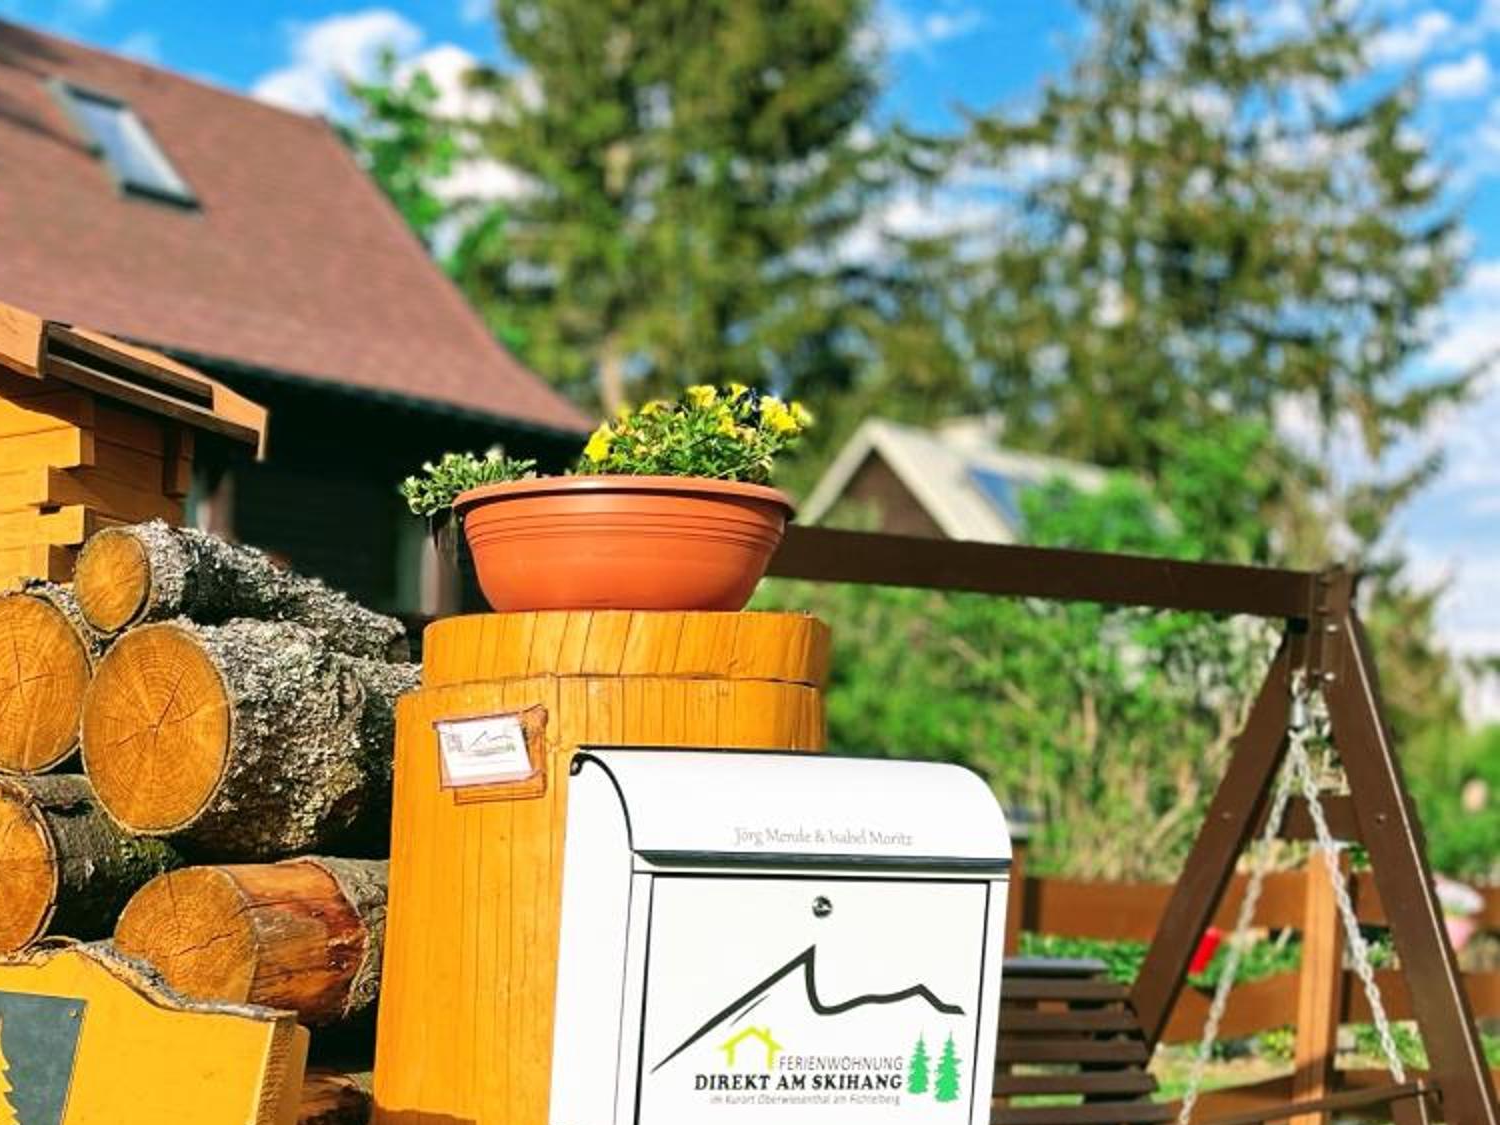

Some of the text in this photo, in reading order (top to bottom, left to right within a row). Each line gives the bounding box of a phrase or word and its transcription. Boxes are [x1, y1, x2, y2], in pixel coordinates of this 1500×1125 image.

[779, 1055, 903, 1071] FERIENWOHNUNG
[694, 1073, 902, 1091] DIREKT AM SKIHANG
